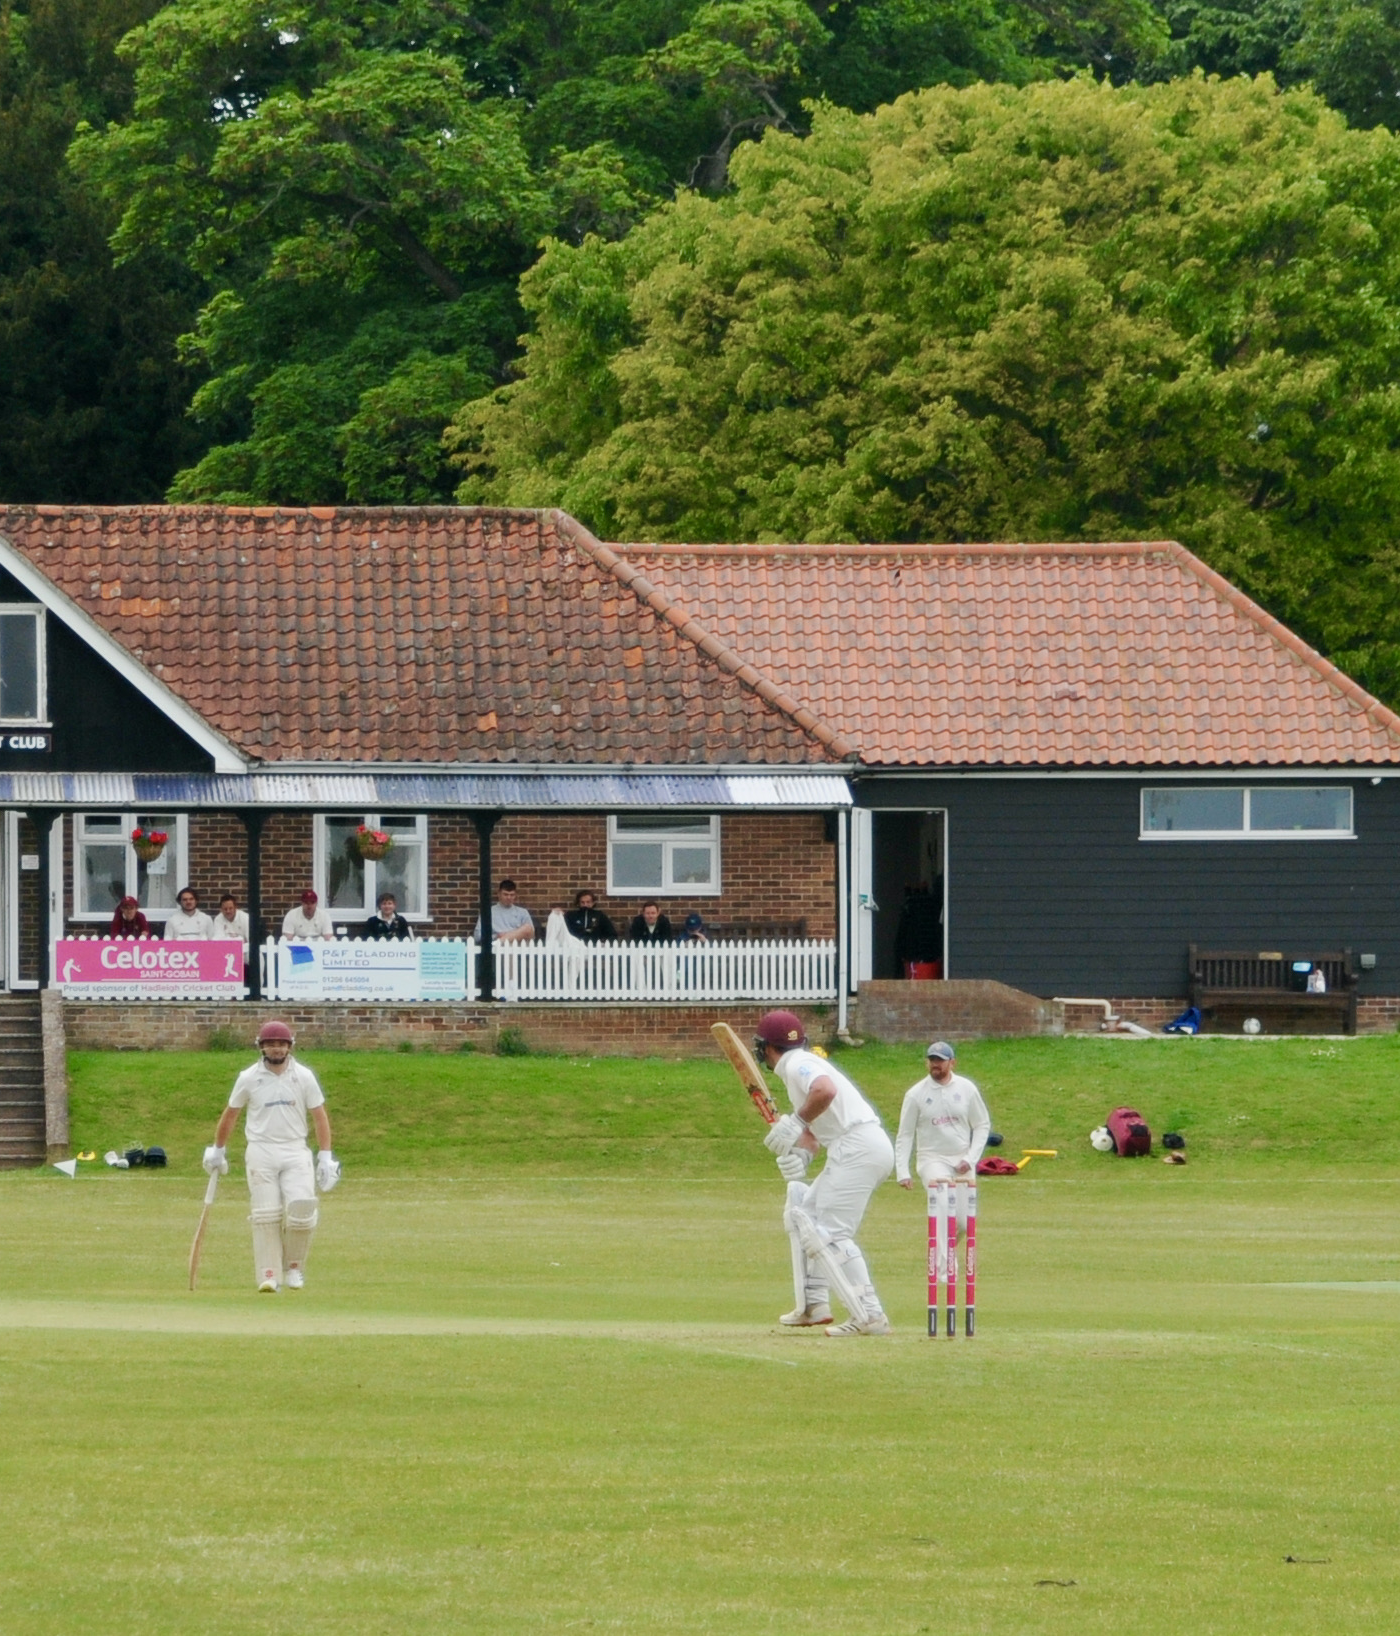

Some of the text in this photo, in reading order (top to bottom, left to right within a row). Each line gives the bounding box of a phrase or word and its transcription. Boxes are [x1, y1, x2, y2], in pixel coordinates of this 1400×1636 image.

[9, 735, 47, 749] CLUB
[100, 945, 199, 969] Celotex
[322, 949, 349, 957] P&F
[140, 970, 200, 979] SAINT-GOBAIN
[63, 984, 90, 992] Proud
[129, 984, 139, 992] of
[141, 984, 180, 993] Hadleigh
[183, 984, 213, 992] Cricket
[215, 984, 236, 992] Club
